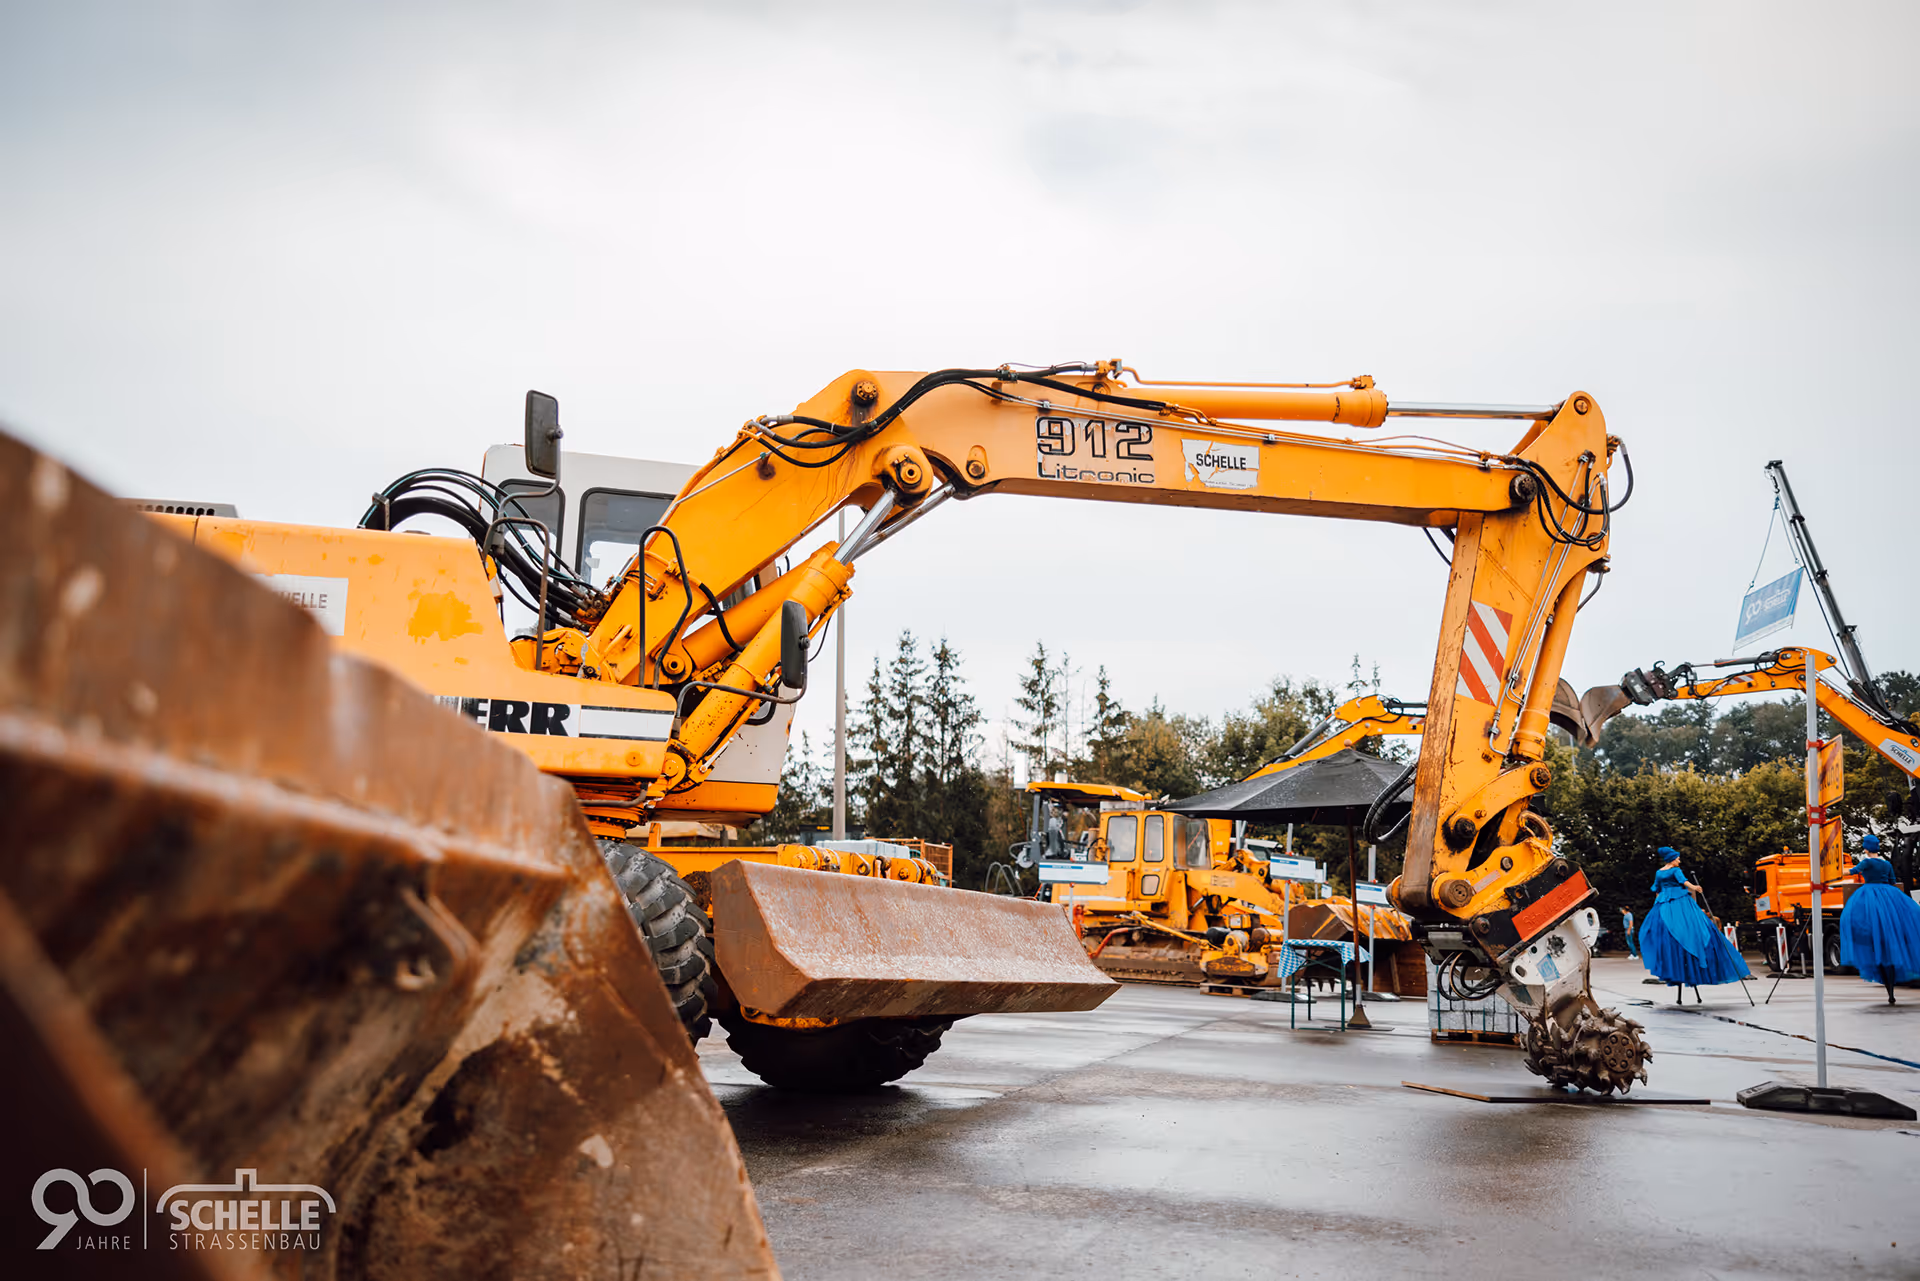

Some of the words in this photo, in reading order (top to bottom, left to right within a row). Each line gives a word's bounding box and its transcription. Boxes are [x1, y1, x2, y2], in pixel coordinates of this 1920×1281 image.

[1036, 416, 1154, 462] 912
[1037, 461, 1155, 484] Litronic
[1195, 452, 1247, 471] SCHELLE
[440, 696, 570, 737] ERR
[1890, 746, 1912, 765] SCHELLE
